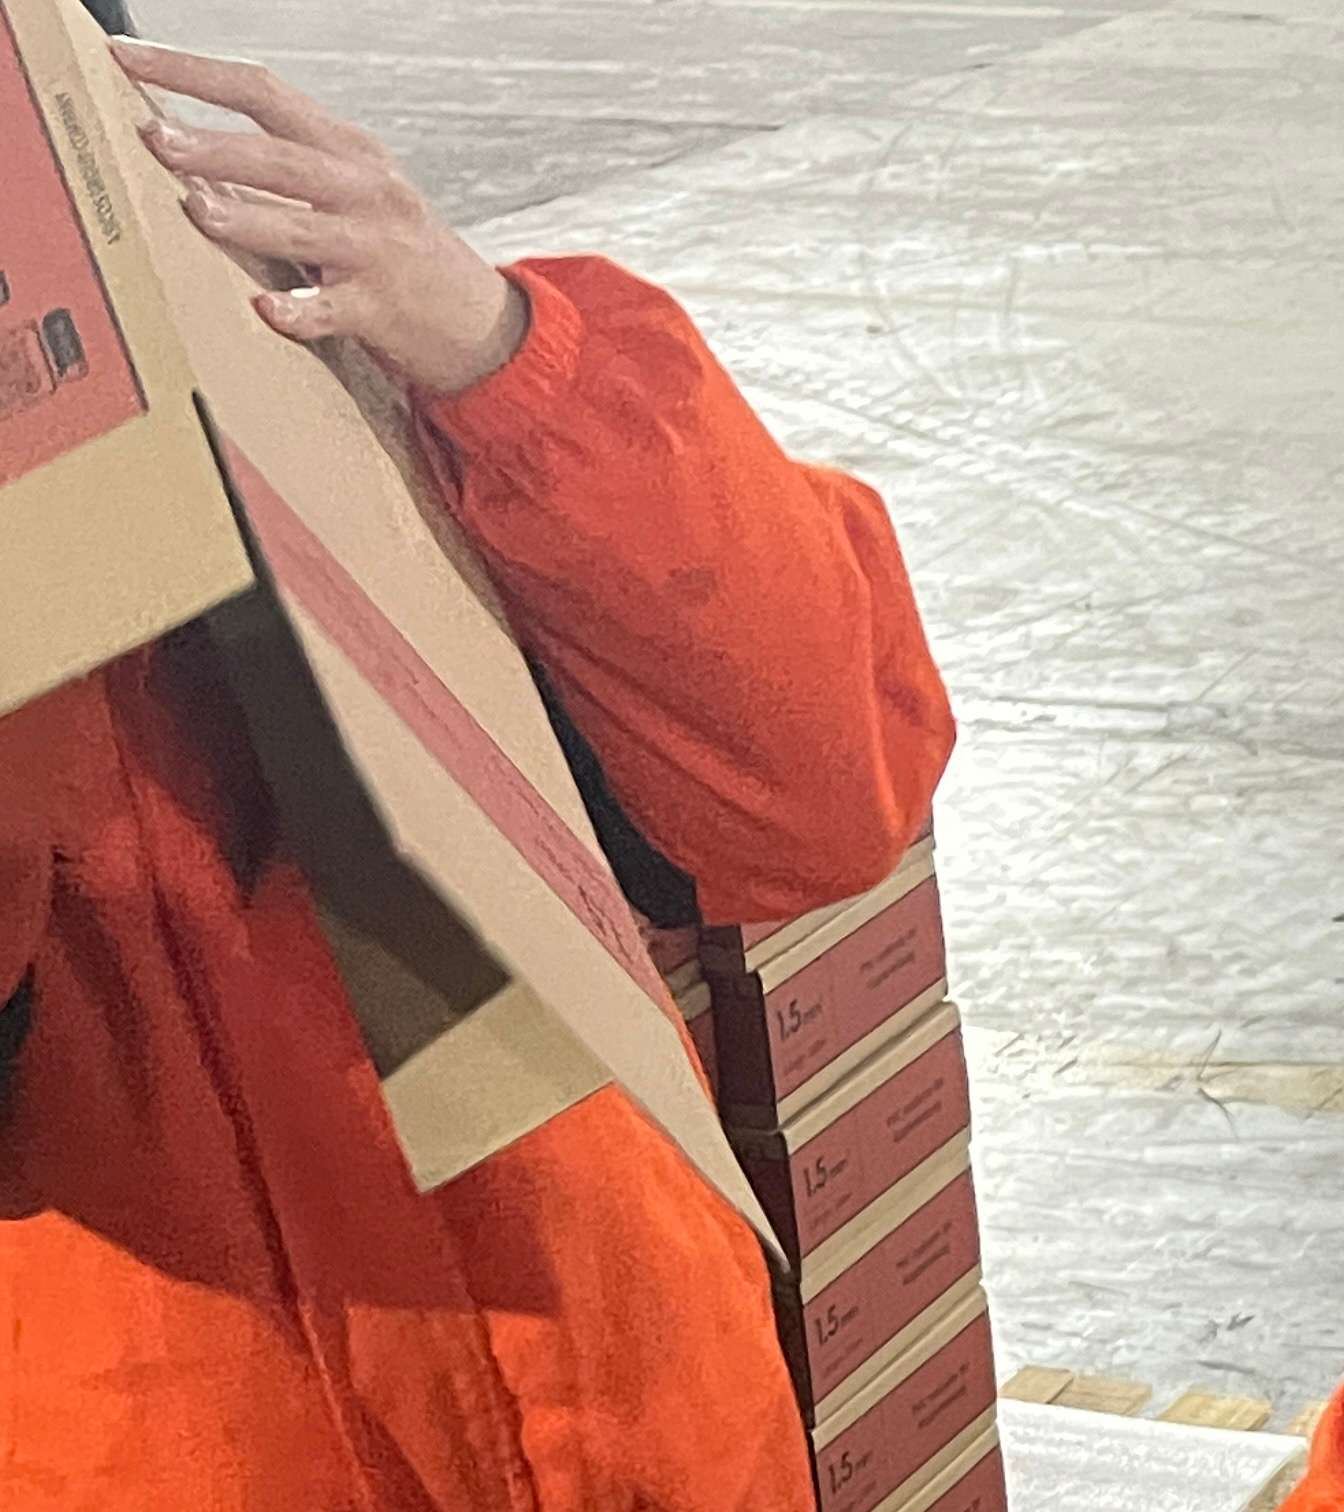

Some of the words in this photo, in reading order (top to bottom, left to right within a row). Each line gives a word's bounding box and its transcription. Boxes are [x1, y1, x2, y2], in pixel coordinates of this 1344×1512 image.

[777, 998, 801, 1042] 1.5
[803, 1155, 828, 1198] 1.5
[815, 1303, 839, 1347] 1.5
[828, 1450, 854, 1495] 1.5
